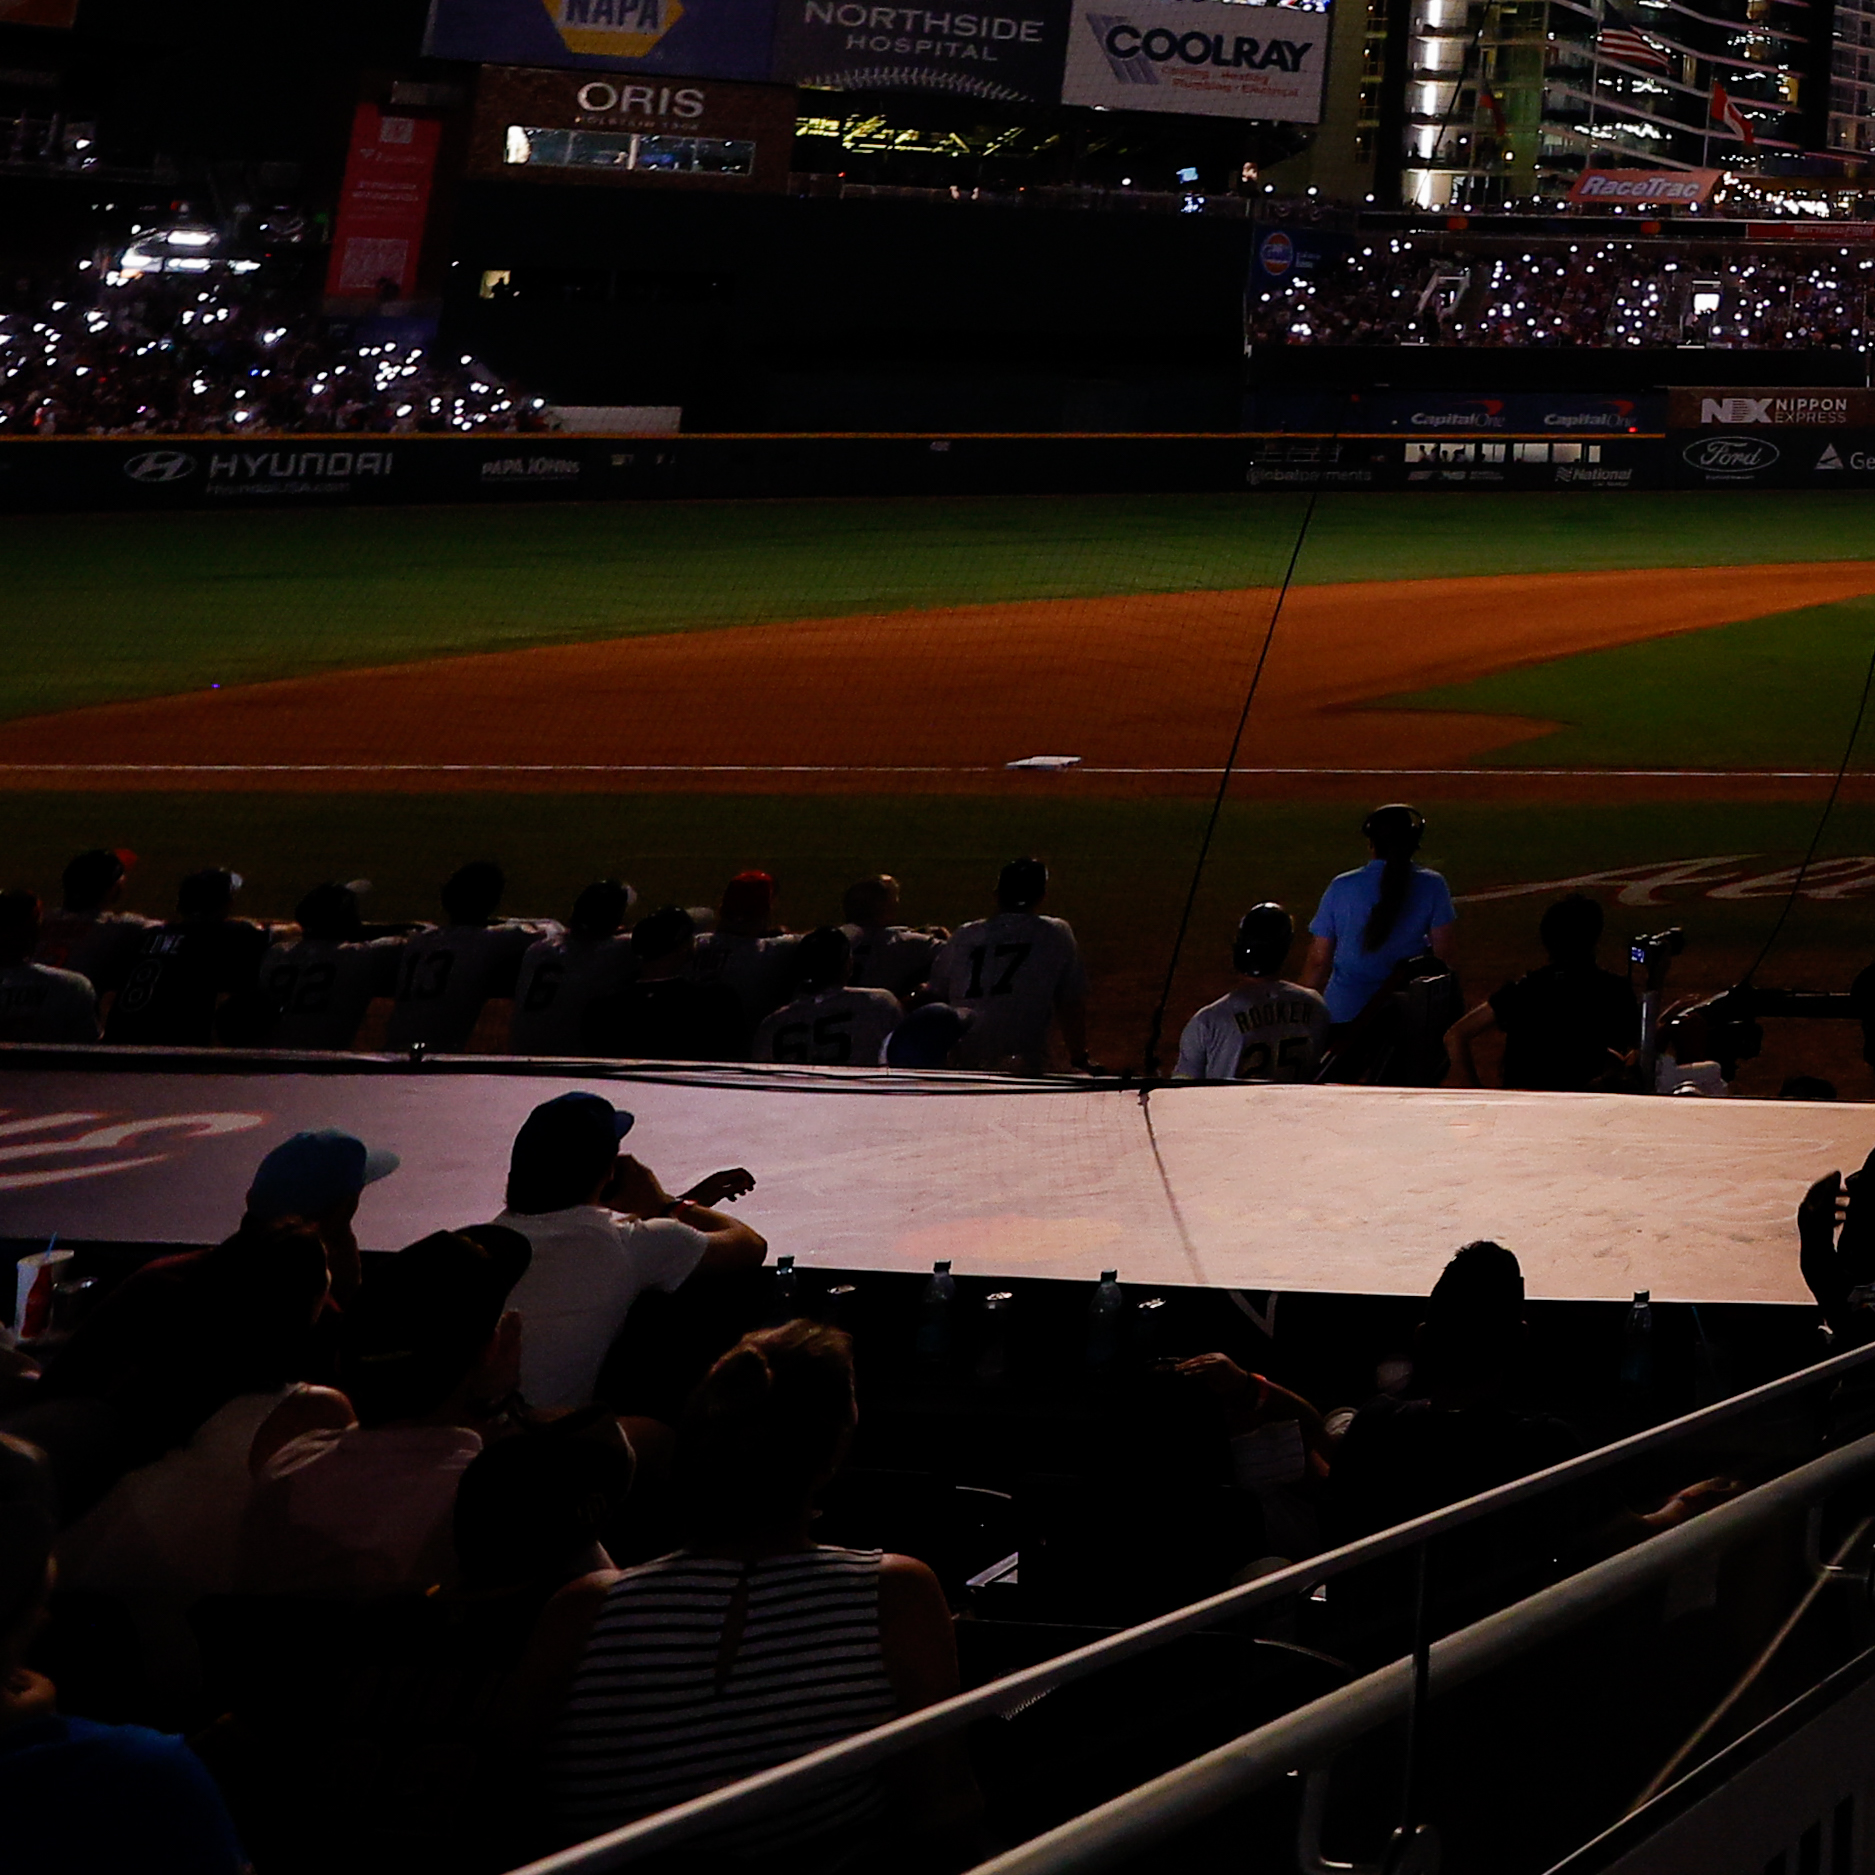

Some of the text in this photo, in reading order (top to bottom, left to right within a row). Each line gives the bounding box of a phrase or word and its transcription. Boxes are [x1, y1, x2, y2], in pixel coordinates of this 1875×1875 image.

[803, 0, 1045, 42] NORTHSIDE
[845, 34, 999, 61] HOSPITAL
[1105, 25, 1313, 73] COOLRAY
[576, 81, 706, 119] ORIS
[1580, 175, 1700, 198] RaceTrac
[1775, 397, 1848, 411] NIPPON
[1775, 412, 1847, 424] EXPRESS
[210, 452, 394, 478] HYUNDAI
[1700, 440, 1763, 467] Ford
[1573, 466, 1632, 482] National
[117, 957, 165, 1014] 8
[269, 963, 338, 1015] 92
[400, 948, 456, 1002] 13
[523, 963, 564, 1012] 6
[965, 942, 1032, 999] 17
[772, 1010, 855, 1062] 65
[1235, 1001, 1313, 1035] ROOKER
[1240, 1035, 1314, 1079] 25
